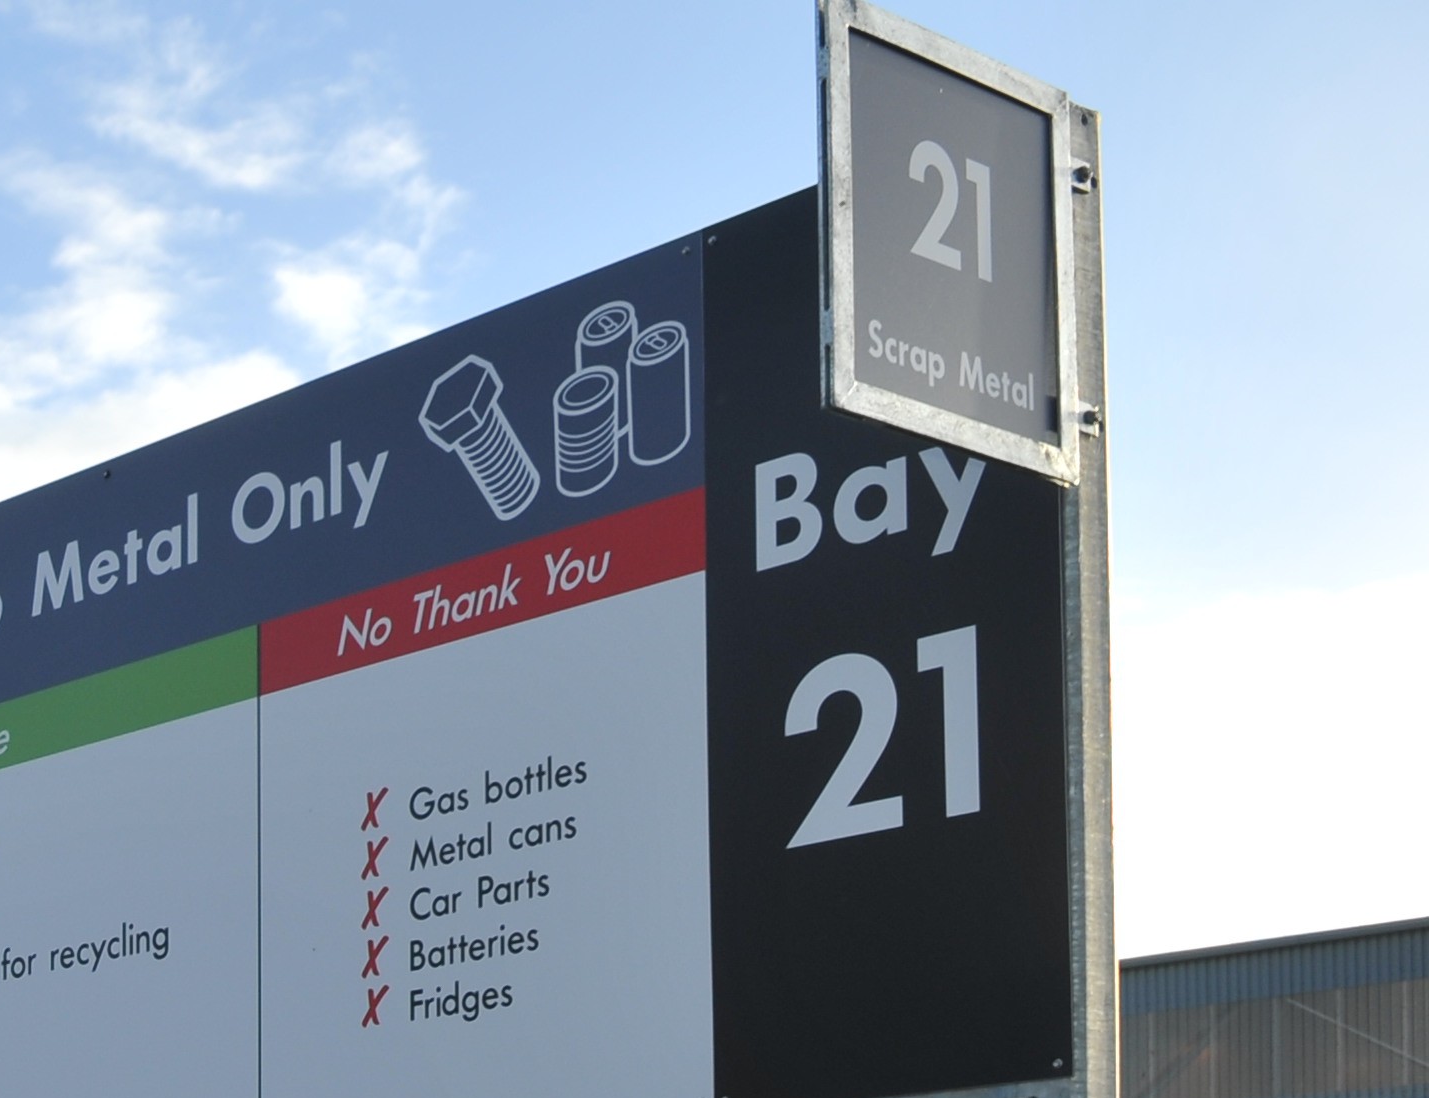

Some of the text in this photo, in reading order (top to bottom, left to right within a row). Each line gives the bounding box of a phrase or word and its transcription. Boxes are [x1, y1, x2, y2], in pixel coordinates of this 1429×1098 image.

[908, 139, 994, 283] 21
[867, 318, 1036, 413] Scrap Metal
[30, 491, 200, 618] Metal
[230, 439, 390, 545] Only
[754, 446, 986, 574] Bay
[336, 546, 612, 657] No Thank You
[784, 623, 982, 850] 21
[408, 754, 588, 821] Gas bottles
[409, 815, 578, 872] Metal cans
[408, 869, 551, 921] Car Parts
[0, 946, 37, 981] for
[49, 921, 170, 973] recycling
[409, 923, 540, 972] Batteries
[409, 979, 514, 1023] Fridges
